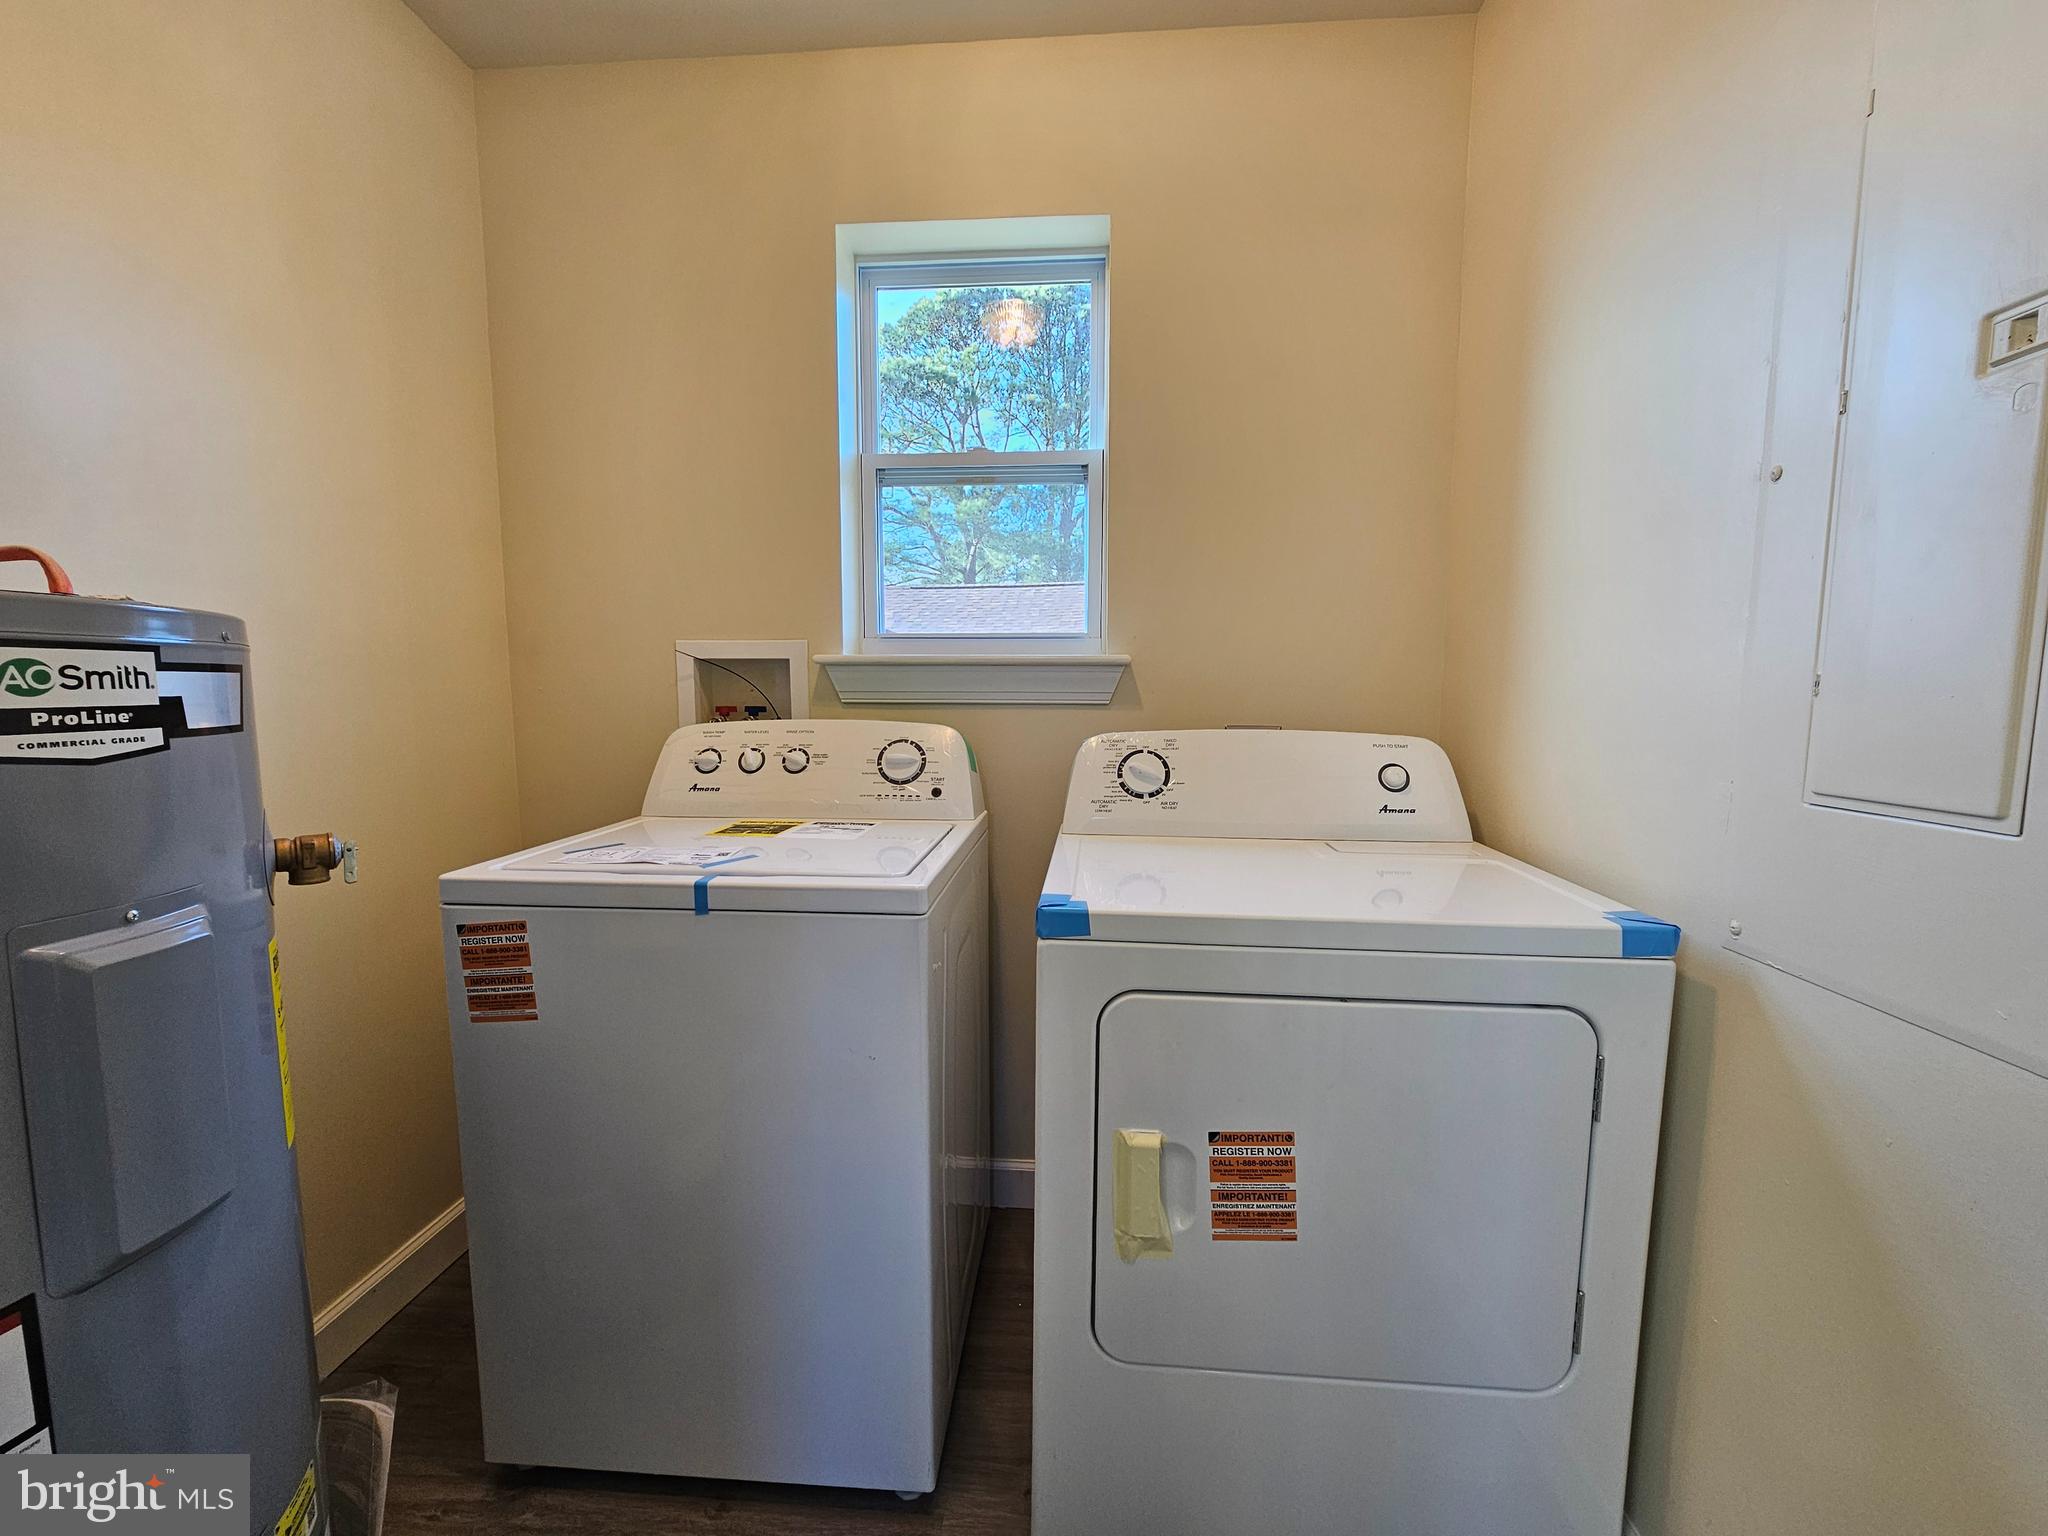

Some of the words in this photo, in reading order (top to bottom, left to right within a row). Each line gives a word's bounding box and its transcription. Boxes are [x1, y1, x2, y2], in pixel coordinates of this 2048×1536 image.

[30, 710, 130, 727] ProLine
[17, 738, 106, 750] COMMERCIAL
[111, 736, 146, 745] GRADE
[688, 783, 721, 792] Amana
[1378, 804, 1416, 814] Amana
[461, 936, 503, 946] REGISTER
[505, 934, 526, 943] NOW
[1221, 1134, 1284, 1142] IMPORTANT!
[1212, 1147, 1264, 1156] REGISTER
[1267, 1147, 1292, 1156] NOW
[1218, 1192, 1288, 1201] IMPORTANTE!
